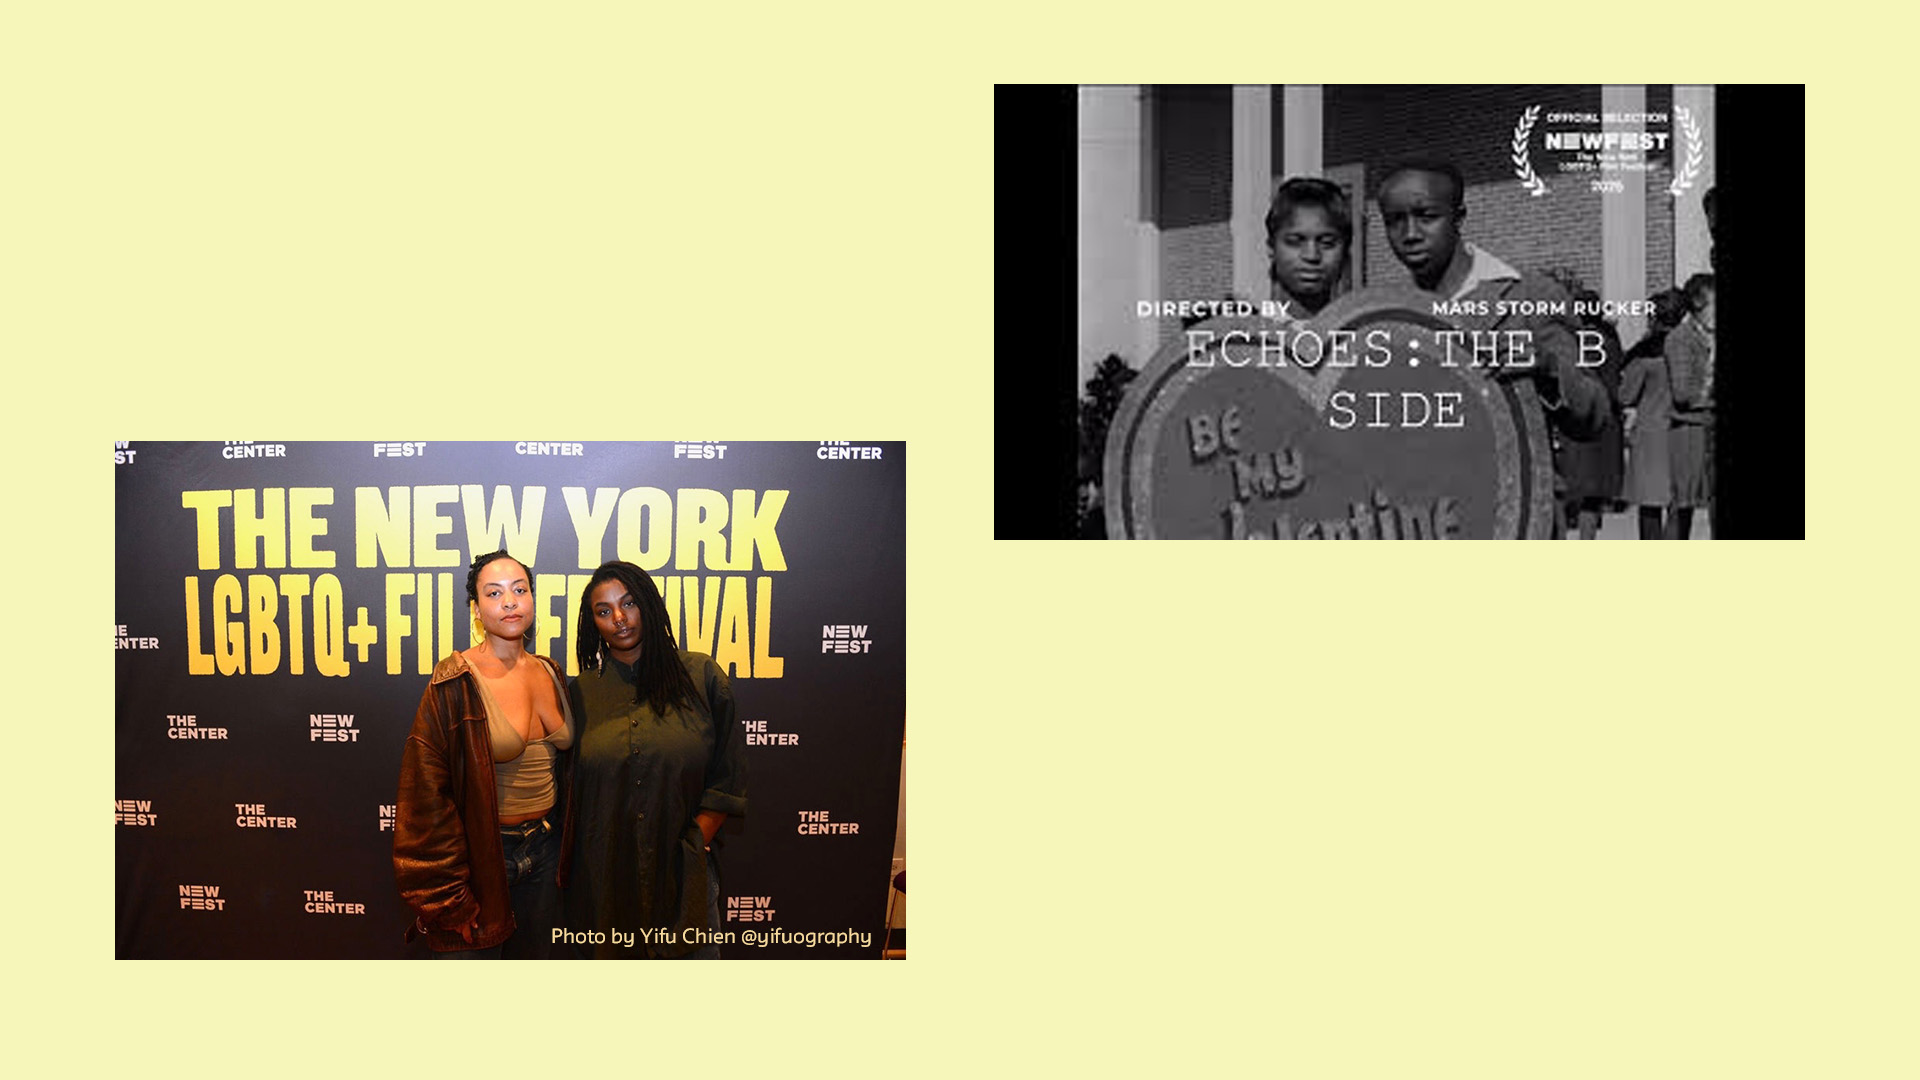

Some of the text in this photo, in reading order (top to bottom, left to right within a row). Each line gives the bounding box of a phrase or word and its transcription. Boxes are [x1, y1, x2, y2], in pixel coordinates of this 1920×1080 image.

[221, 444, 287, 459] CENTER
[373, 441, 427, 458] FEST
[514, 441, 584, 456] CENTER
[674, 444, 728, 460] FEST
[816, 446, 883, 460] CENTER
[115, 450, 137, 465] ST
[182, 484, 790, 571] THE NEW YORK
[385, 572, 486, 676] FIL
[822, 624, 868, 638] NEW
[115, 637, 160, 650] NTER
[822, 640, 872, 654] FEST
[167, 715, 197, 727] THE
[309, 714, 355, 728] NEW
[742, 720, 768, 733] HE
[167, 727, 229, 740] CENTER
[310, 729, 360, 743] FEST
[745, 733, 800, 746] ENTER
[235, 804, 266, 816] THE
[798, 810, 830, 823] THE
[236, 816, 298, 829] CENTER
[797, 822, 860, 836] CENTER
[179, 884, 220, 898] NEW
[304, 890, 334, 902] THE
[180, 898, 226, 911] FEST
[304, 902, 366, 915] CENTER
[727, 896, 772, 909] NEW
[727, 909, 776, 923] FEST
